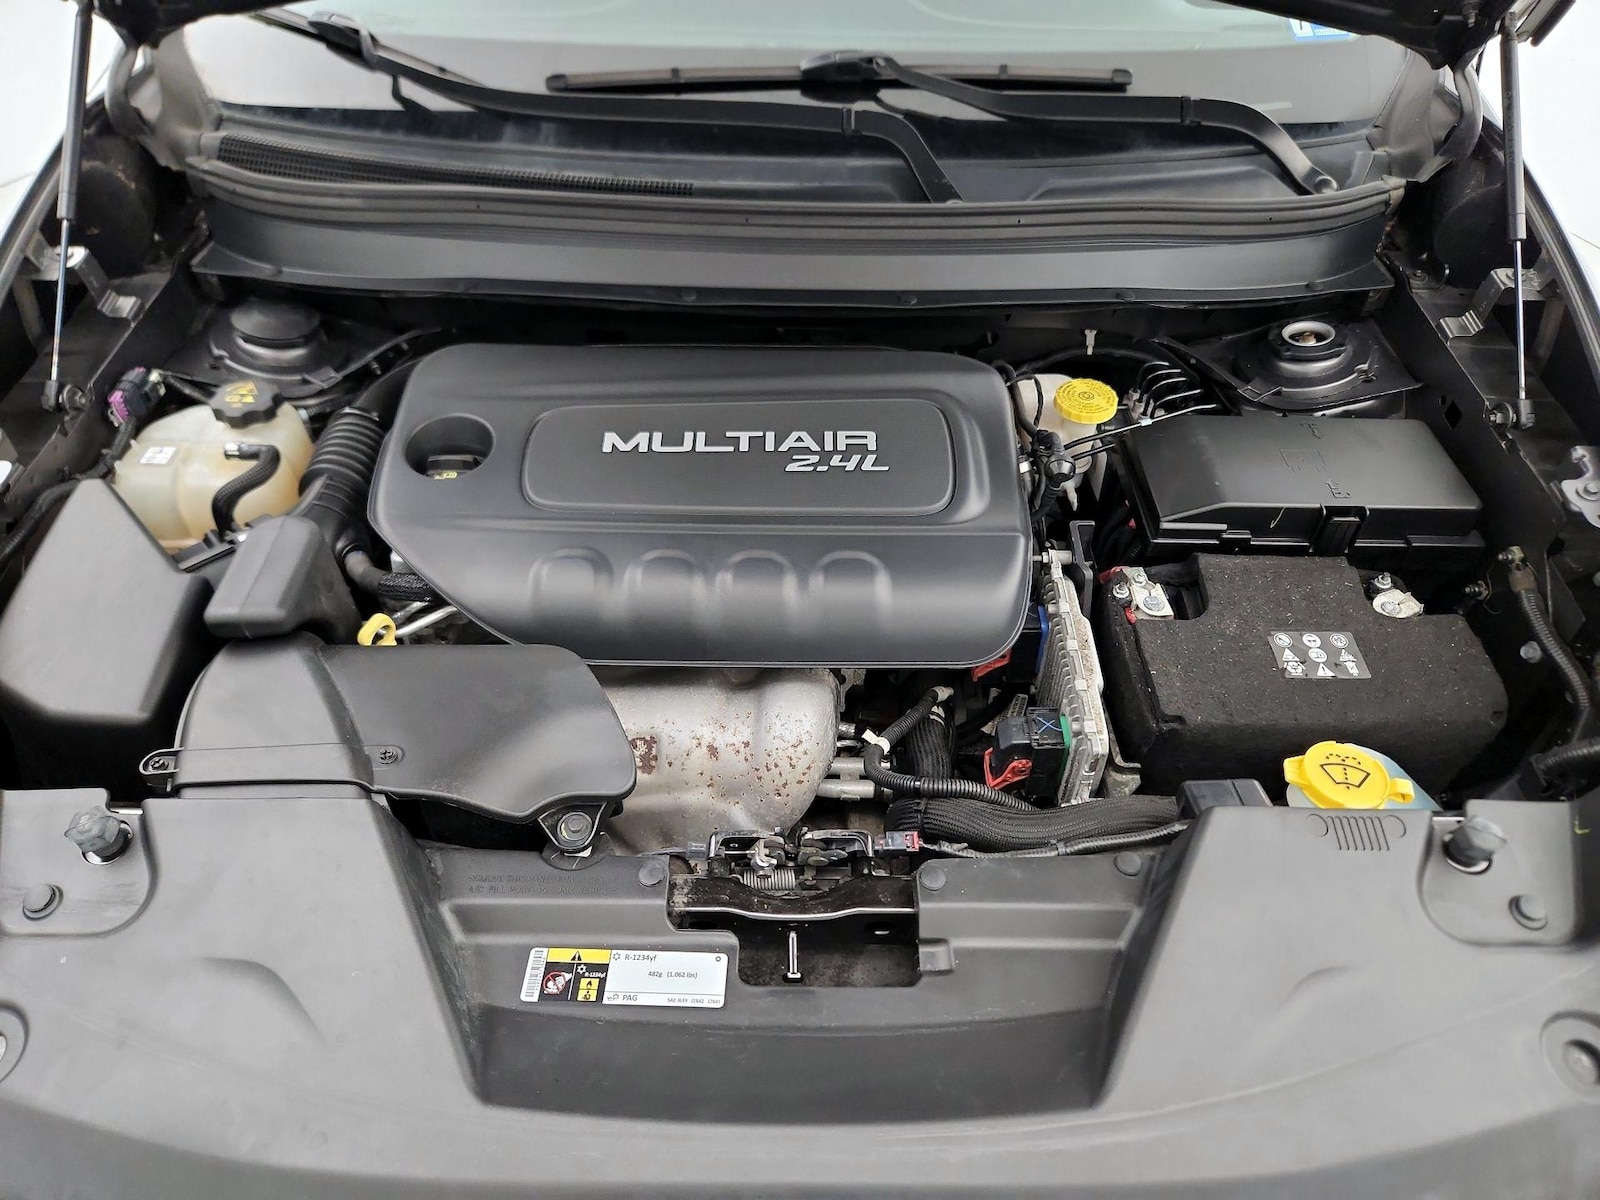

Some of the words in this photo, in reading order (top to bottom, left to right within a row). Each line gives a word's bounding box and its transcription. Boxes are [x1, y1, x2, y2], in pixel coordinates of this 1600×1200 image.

[602, 430, 878, 453] MULTIAIR
[785, 454, 890, 472] 2.4L
[625, 954, 657, 963] R-1234yf
[648, 971, 663, 979] 482g
[666, 971, 685, 979] (1.062
[686, 972, 698, 980] lbs)
